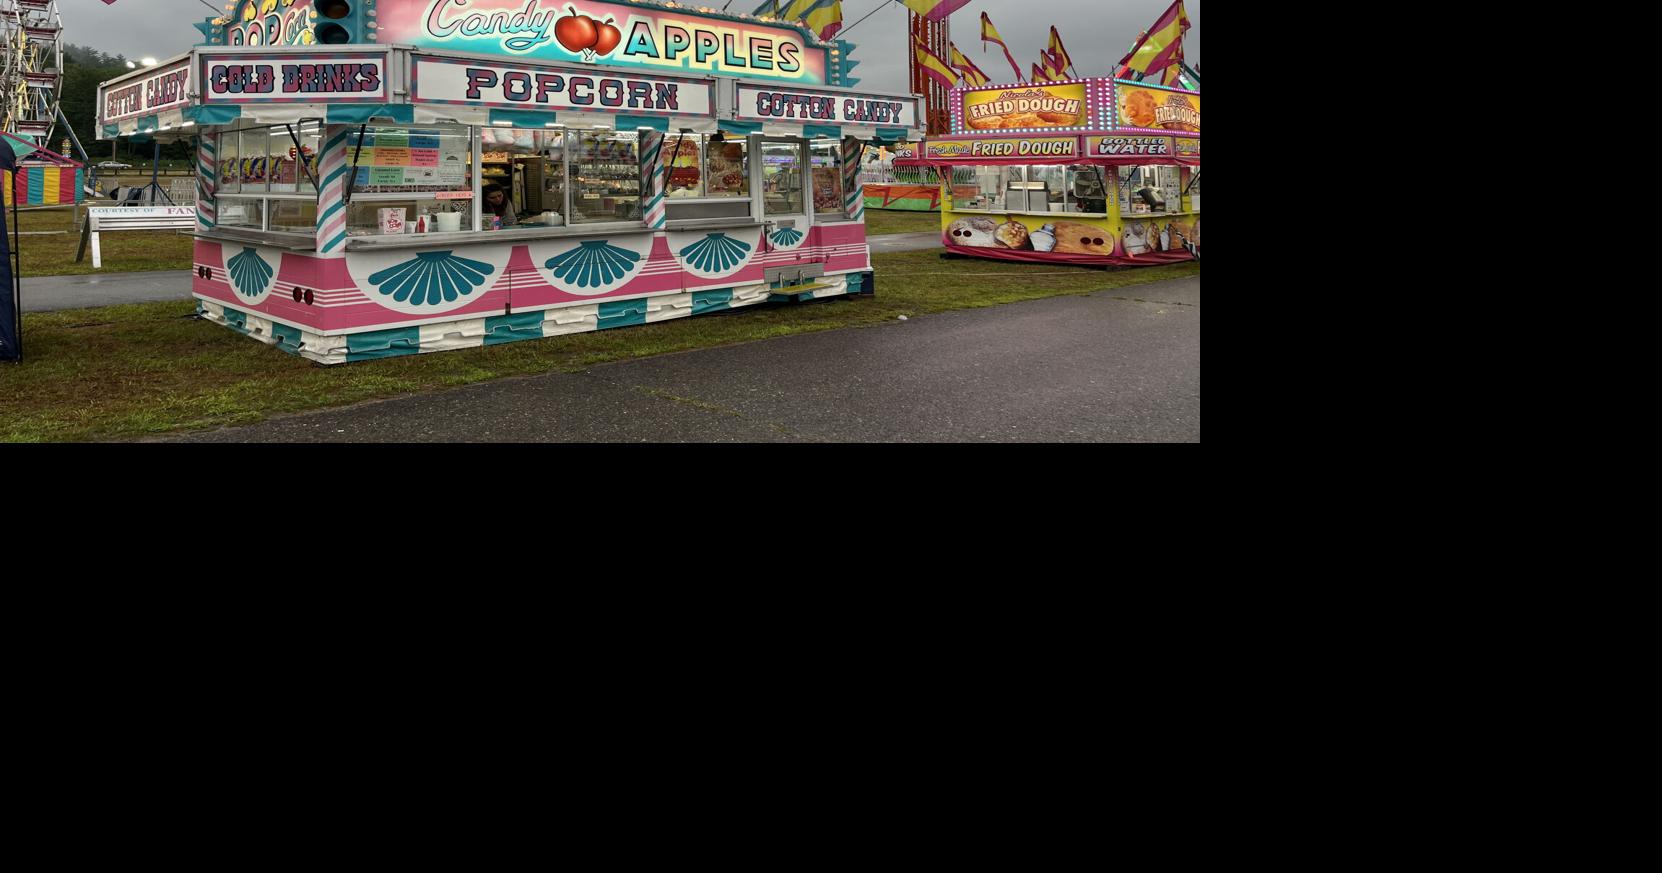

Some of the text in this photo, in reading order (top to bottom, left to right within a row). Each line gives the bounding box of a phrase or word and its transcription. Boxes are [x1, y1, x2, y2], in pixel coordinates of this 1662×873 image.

[427, 0, 800, 72] Candy APPLES
[107, 68, 189, 118] COTTON CANDY
[210, 63, 381, 93] COLD DRINKS
[466, 68, 679, 110] POPCORN
[756, 91, 902, 124] COTTON CANDY
[969, 98, 1080, 119] FRIED DOUGH
[971, 142, 1014, 156] FRIED
[1018, 141, 1073, 156] DOUGH
[1099, 144, 1167, 155] WATER
[1102, 137, 1165, 145] BOTTLED
